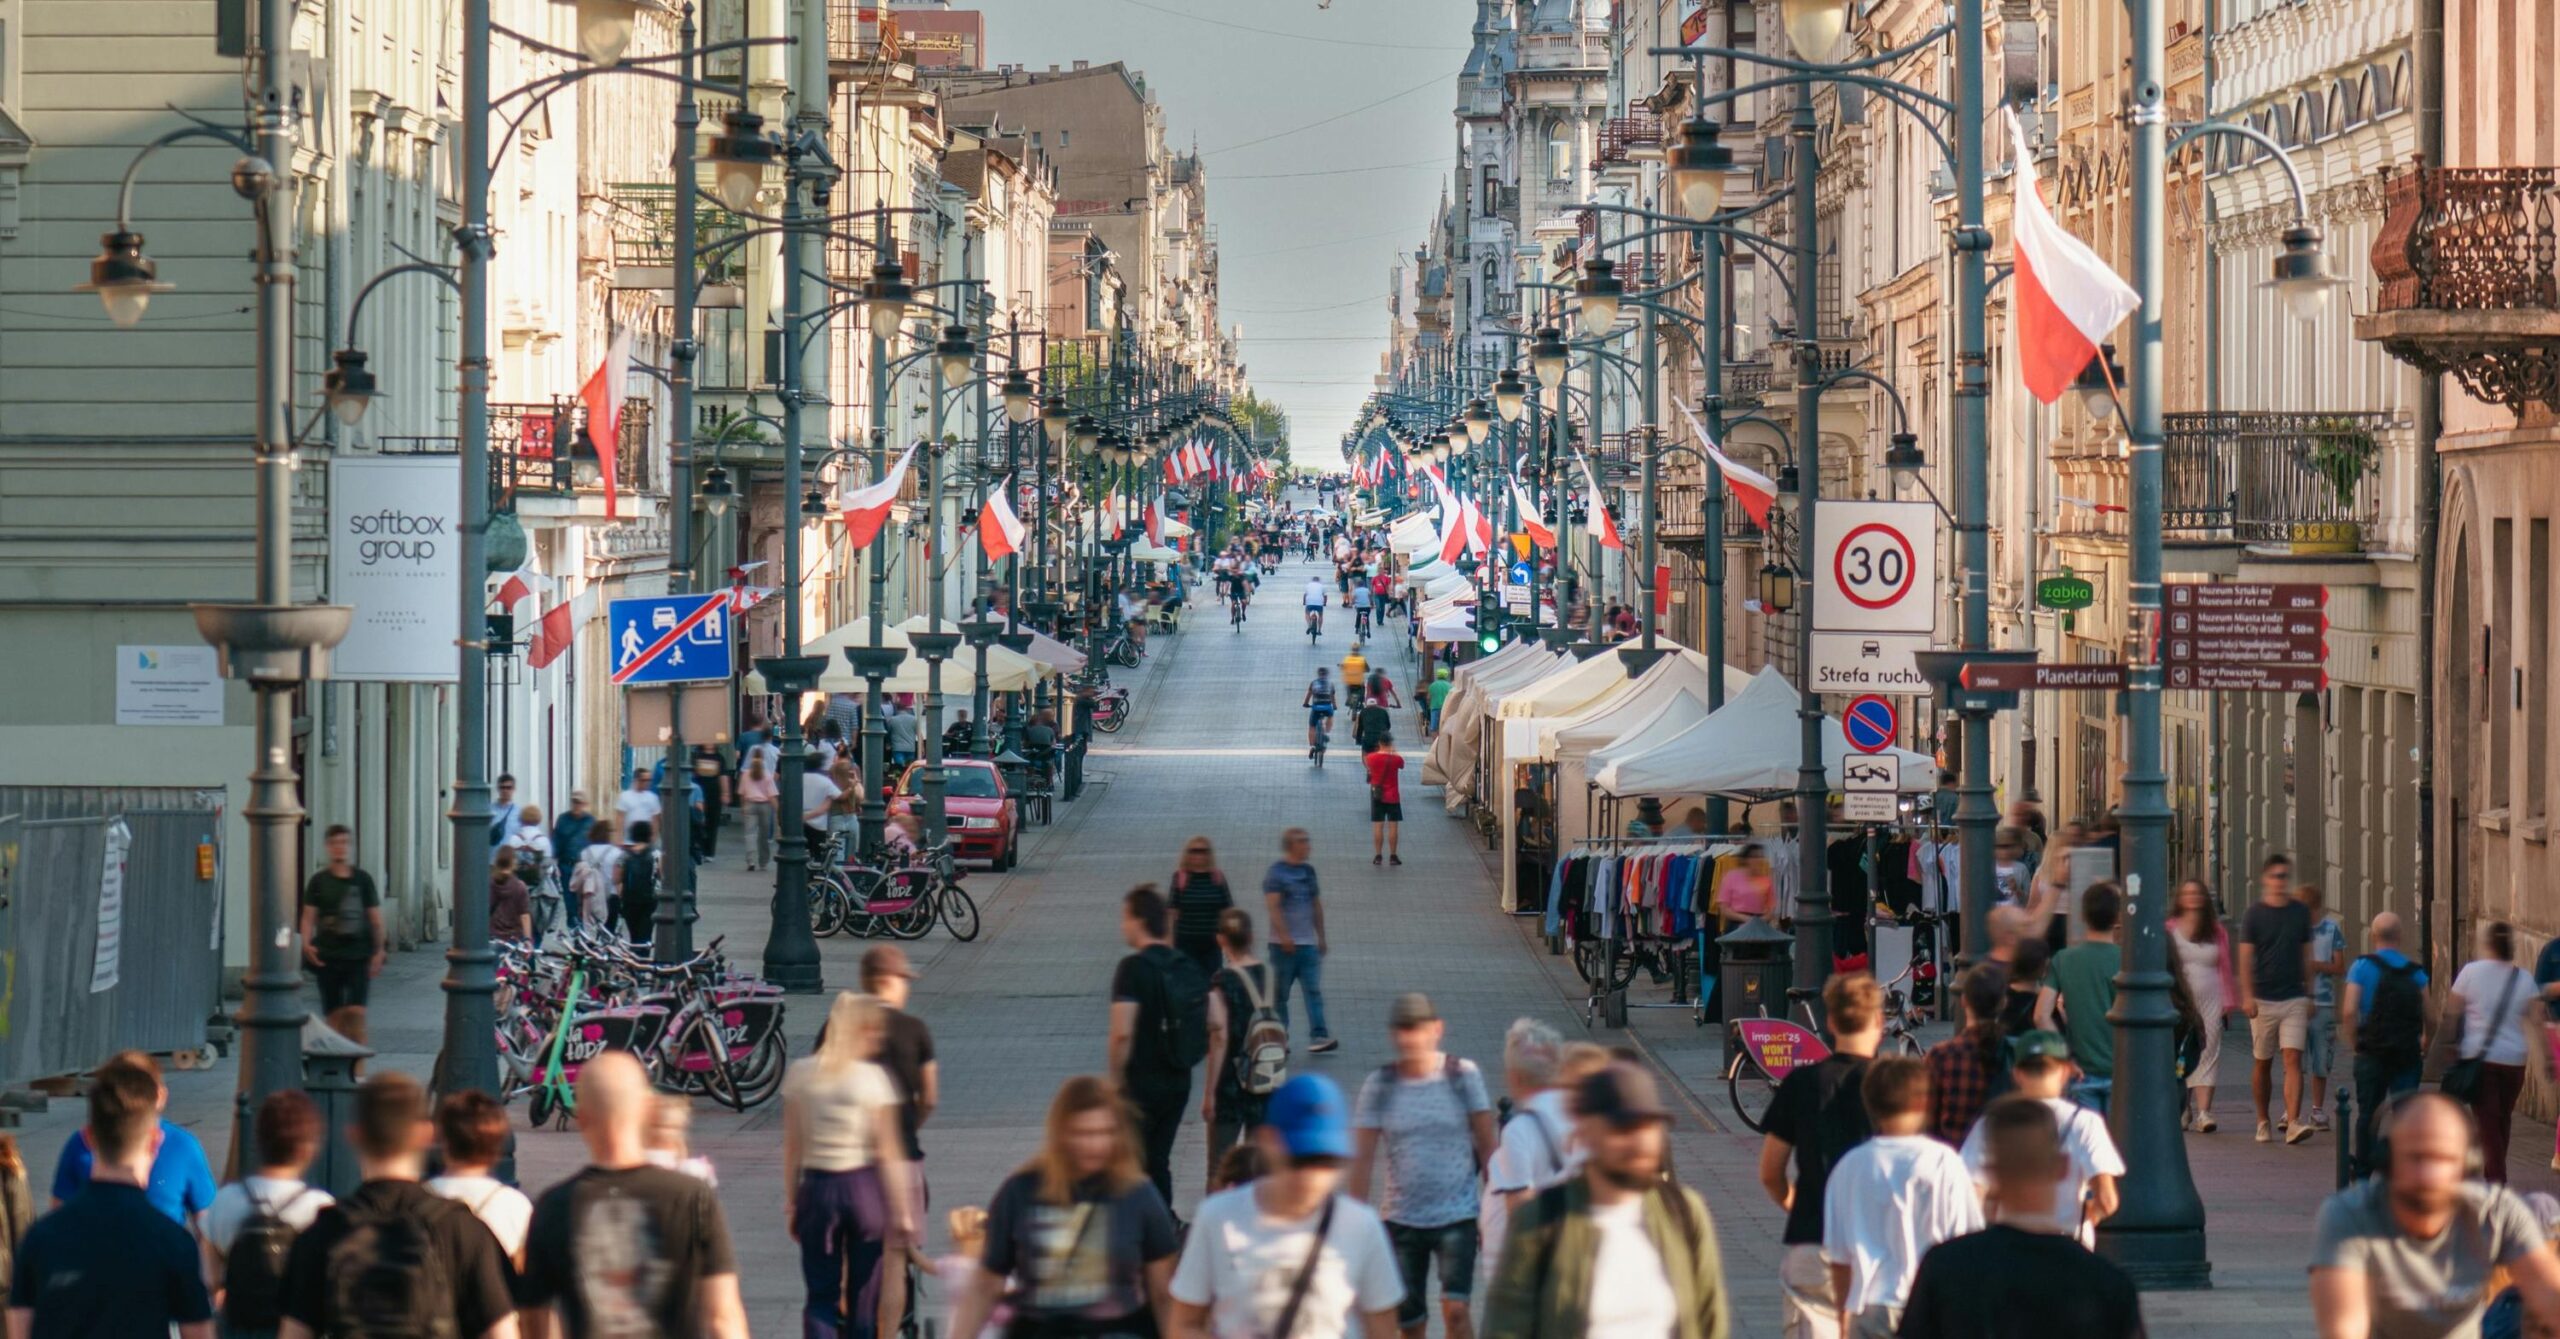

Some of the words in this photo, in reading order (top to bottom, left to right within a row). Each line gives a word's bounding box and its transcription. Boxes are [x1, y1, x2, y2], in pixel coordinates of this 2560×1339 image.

[350, 509, 445, 535] softbox
[360, 540, 435, 566] group
[1848, 547, 1903, 586] 30
[2044, 584, 2089, 599] żabka
[2198, 586, 2233, 595] Muzeum
[2235, 585, 2259, 595] Sztuki
[2198, 598, 2233, 606] Museum
[2234, 597, 2243, 606] of
[2244, 598, 2256, 606] Art
[2291, 598, 2315, 607] 820m
[2198, 613, 2233, 622] Muzeum
[2234, 613, 2260, 622] Miasta
[2198, 625, 2225, 633] Museum
[2226, 624, 2233, 633] of
[2234, 624, 2244, 633] the
[2245, 624, 2258, 635] City
[2291, 624, 2315, 634] 450m
[1819, 666, 1869, 682] Strefa
[1878, 668, 1924, 683] ruchu
[2036, 668, 2119, 684] Planetarium
[2199, 667, 2218, 676] Teatr
[2220, 667, 2267, 679] Powszechny
[1761, 1044, 1793, 1055] WON'T
[1764, 1055, 1793, 1067] WAIT!
